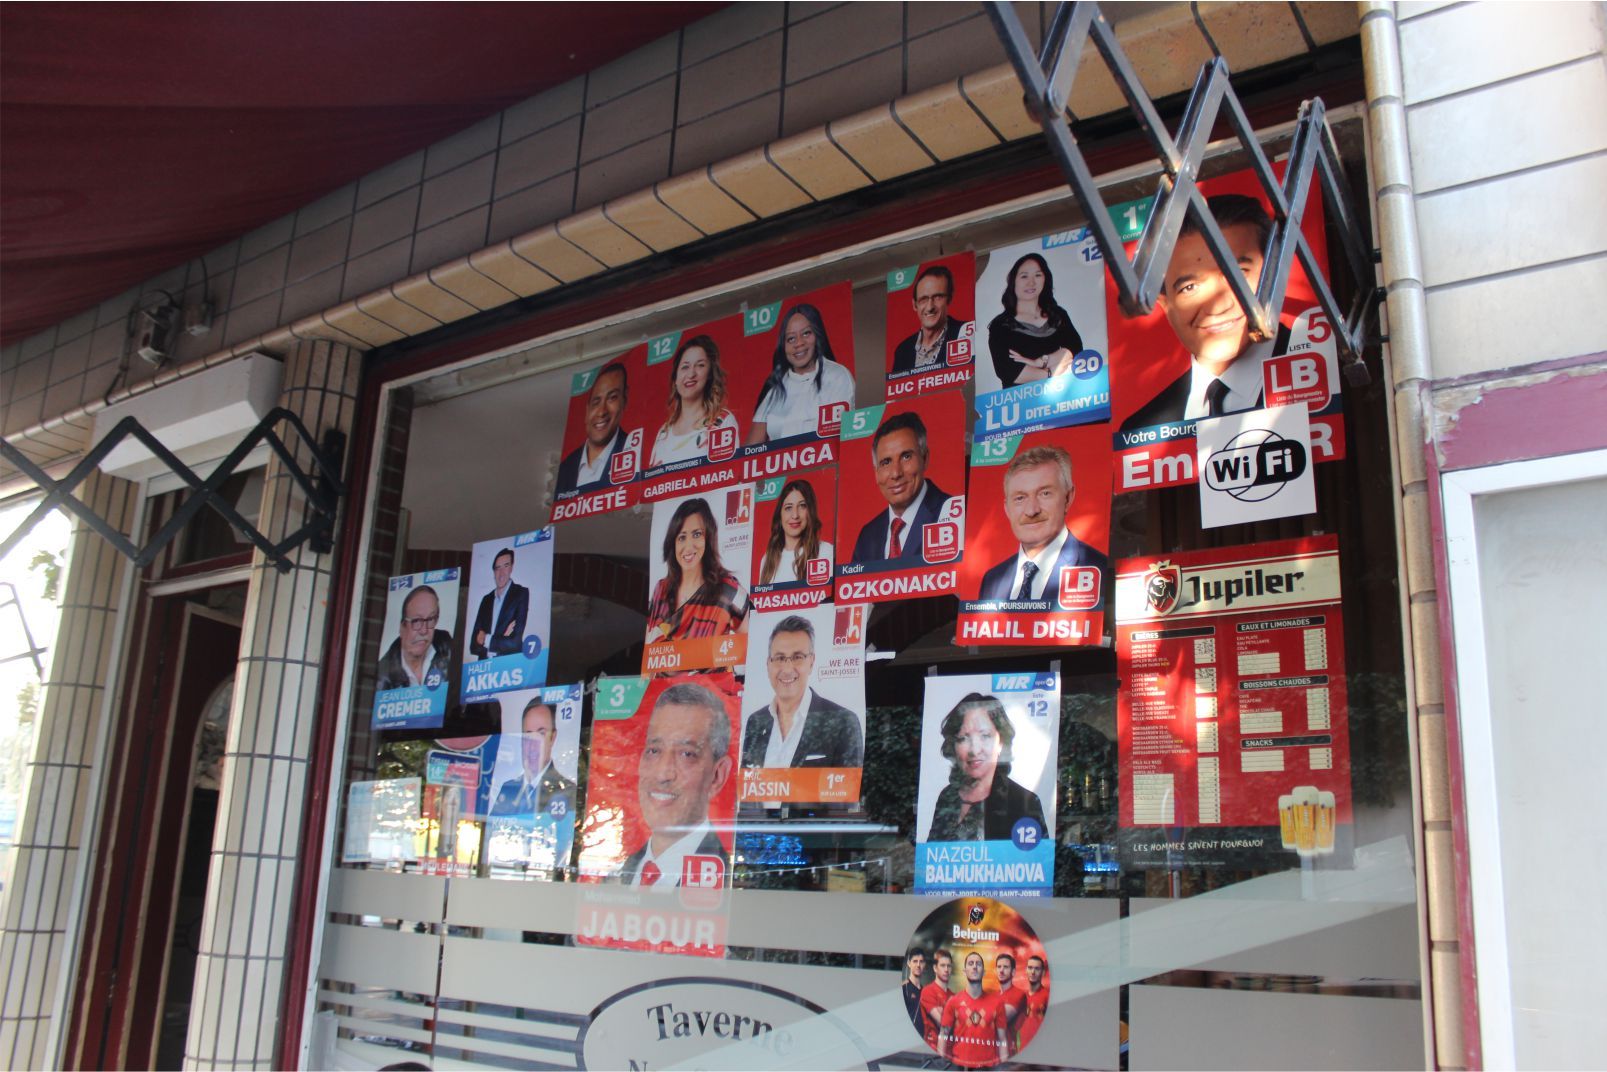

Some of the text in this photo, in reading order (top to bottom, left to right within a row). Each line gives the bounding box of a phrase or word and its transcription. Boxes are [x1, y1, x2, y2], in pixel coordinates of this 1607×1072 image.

[1123, 204, 1146, 230] 1er
[1046, 229, 1081, 248] MR
[1082, 247, 1102, 262] 12
[965, 323, 974, 337] 5
[1308, 311, 1331, 343] 5
[949, 342, 968, 357] LB
[1289, 342, 1312, 352] LISTE
[1075, 356, 1100, 373] 20
[1270, 358, 1319, 394] LB
[888, 380, 914, 397] LUC
[985, 379, 1064, 409] JUANRONG
[821, 405, 843, 426] LB
[986, 393, 1109, 431] LU DITE JENNY LU
[631, 432, 640, 447] 5
[712, 429, 734, 451] LB
[1123, 427, 1157, 445] Votre
[745, 444, 768, 456] Dorah
[613, 456, 633, 472] LB
[743, 443, 834, 479] ILUNGA
[643, 470, 734, 499] GABRIELA MARA
[553, 486, 627, 520] BOÏKETÉ
[557, 489, 579, 501] Philippe
[949, 499, 963, 519] 5
[516, 533, 537, 546] MR
[927, 527, 954, 548] LB
[809, 561, 827, 576] LB
[842, 564, 865, 574] Kadir
[839, 571, 957, 600] OZKONAKCI
[1065, 571, 1094, 592] LB
[1184, 569, 1304, 607] Jupiler
[753, 590, 827, 610] HASANOVA
[965, 601, 998, 611] Ensemble,
[999, 602, 1046, 611] POURSUIVONS
[963, 621, 1090, 639] HALIL DISLI
[1241, 623, 1259, 631] EAUX
[1270, 619, 1310, 628] LIMONADES
[528, 641, 536, 653] 7
[649, 645, 675, 656] MALIKA
[647, 654, 681, 669] MADI
[829, 658, 860, 667] WE ARE
[427, 674, 441, 687] 29
[466, 668, 524, 693] AKKAS
[995, 676, 1031, 690] MR
[1243, 678, 1311, 689] BOISSONS CHAUDES
[543, 688, 567, 701] MR
[377, 699, 432, 719] CREMER
[561, 707, 573, 720] 12
[1027, 700, 1048, 717] 12
[1245, 739, 1273, 747] SNACKS
[827, 773, 845, 789] 1er
[741, 782, 790, 800] JASSIN
[551, 801, 566, 815] 23
[1017, 827, 1036, 844] 12
[1133, 839, 1264, 852] LES HOMMES SAVENT POURQUOI
[927, 847, 993, 862] NAZGUL
[686, 860, 719, 889] LB
[925, 863, 1045, 884] BALMUKHANOVA
[582, 911, 716, 950] JABOUR
[952, 924, 1000, 943] Belgium
[647, 1002, 795, 1057] Taverne
